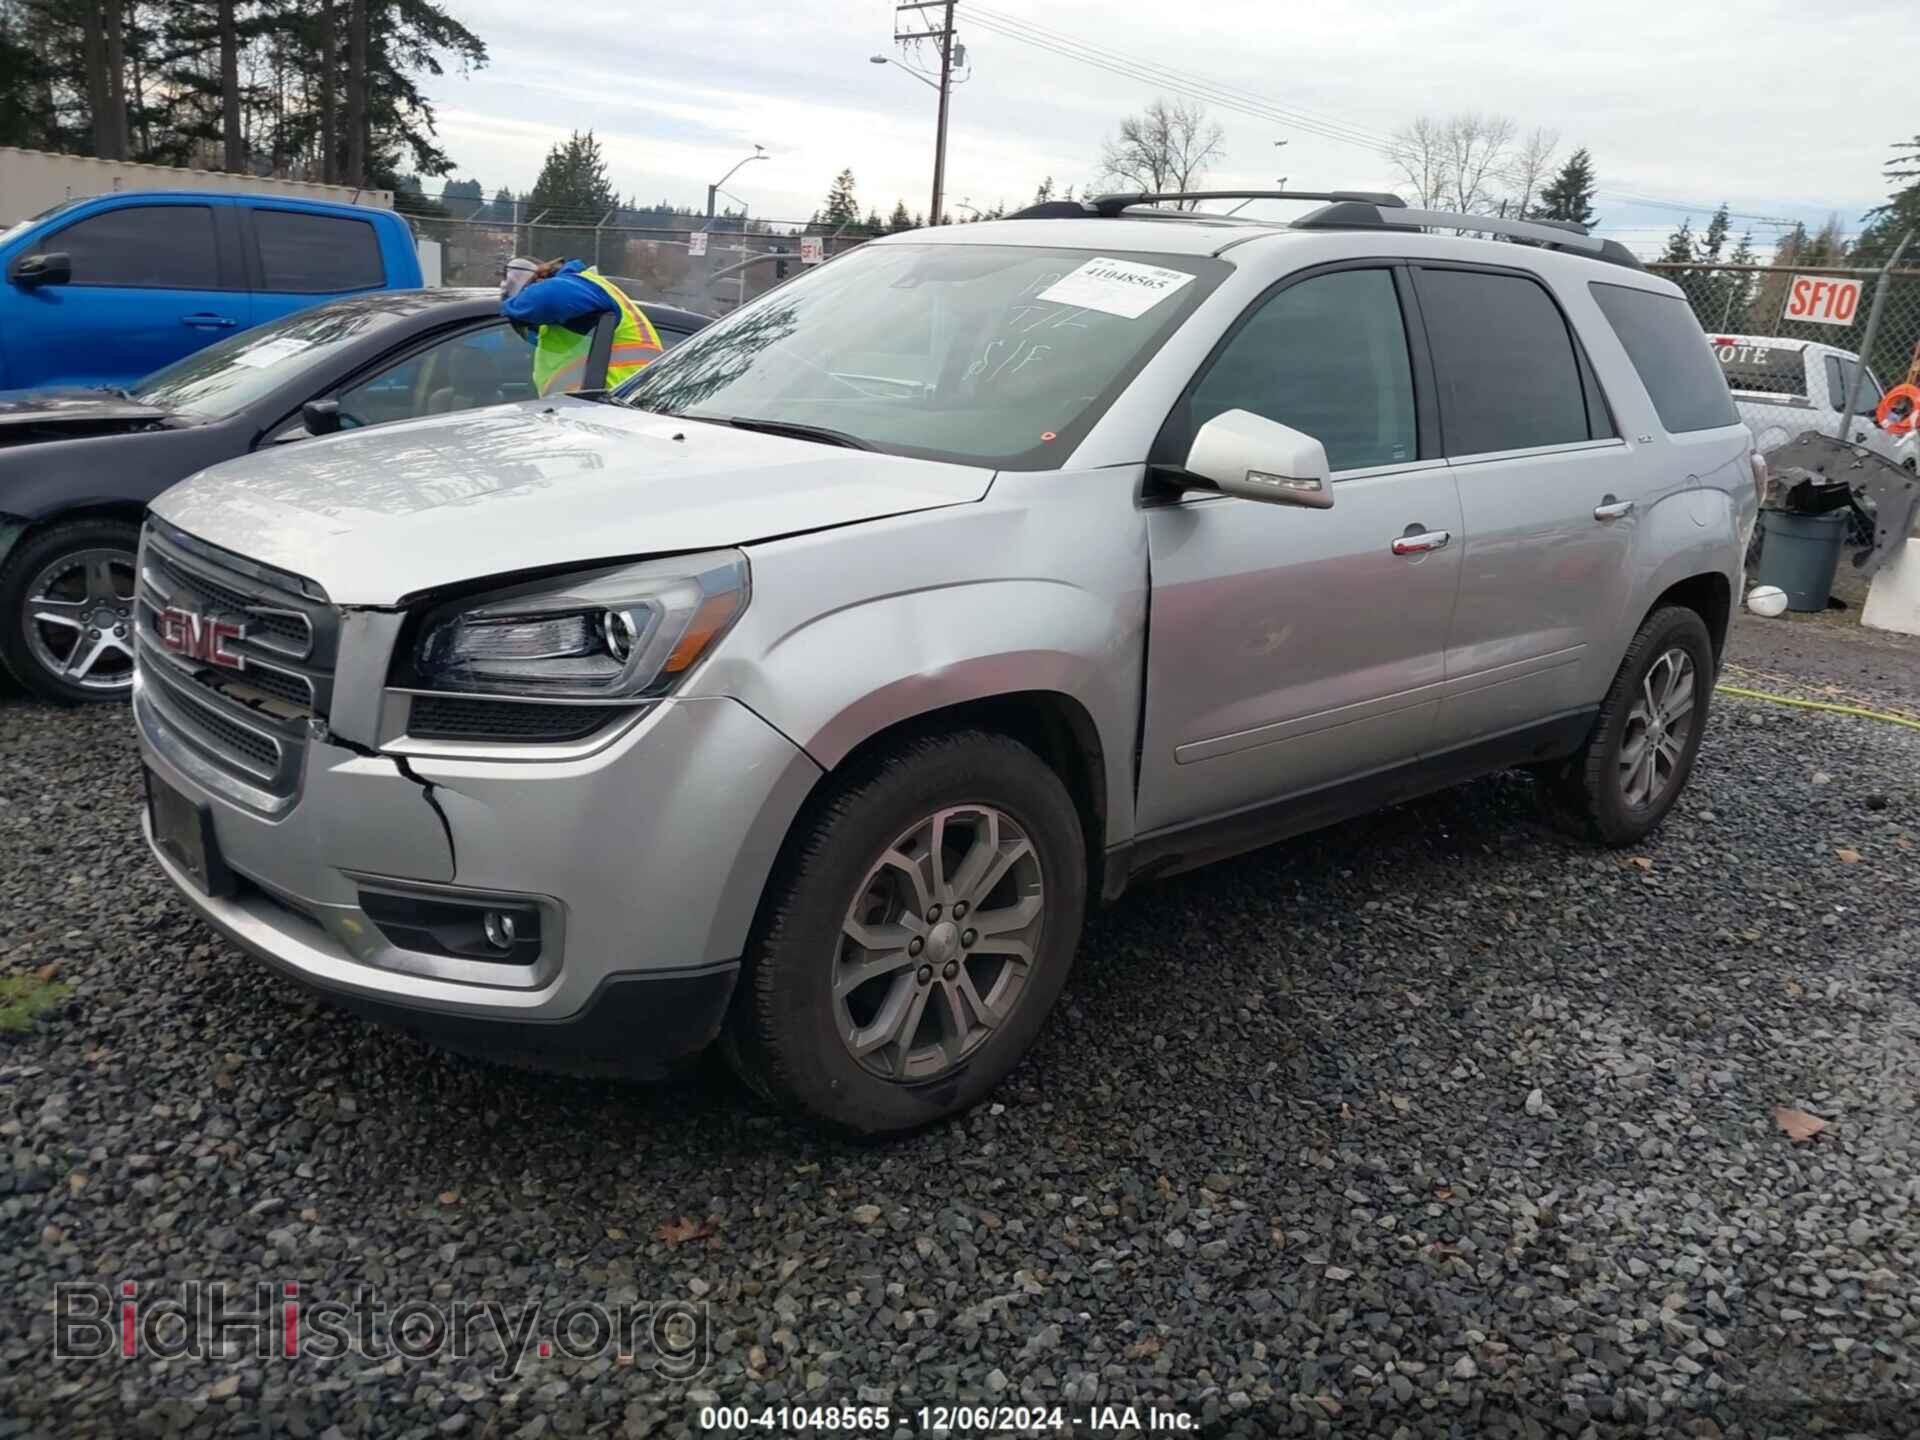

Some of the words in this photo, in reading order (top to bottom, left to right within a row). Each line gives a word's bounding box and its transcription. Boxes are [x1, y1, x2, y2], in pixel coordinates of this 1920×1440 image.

[1086, 267, 1171, 290] 41048565
[1790, 280, 1857, 321] SF10
[1714, 345, 1771, 365] OTE
[160, 606, 246, 671] GMC
